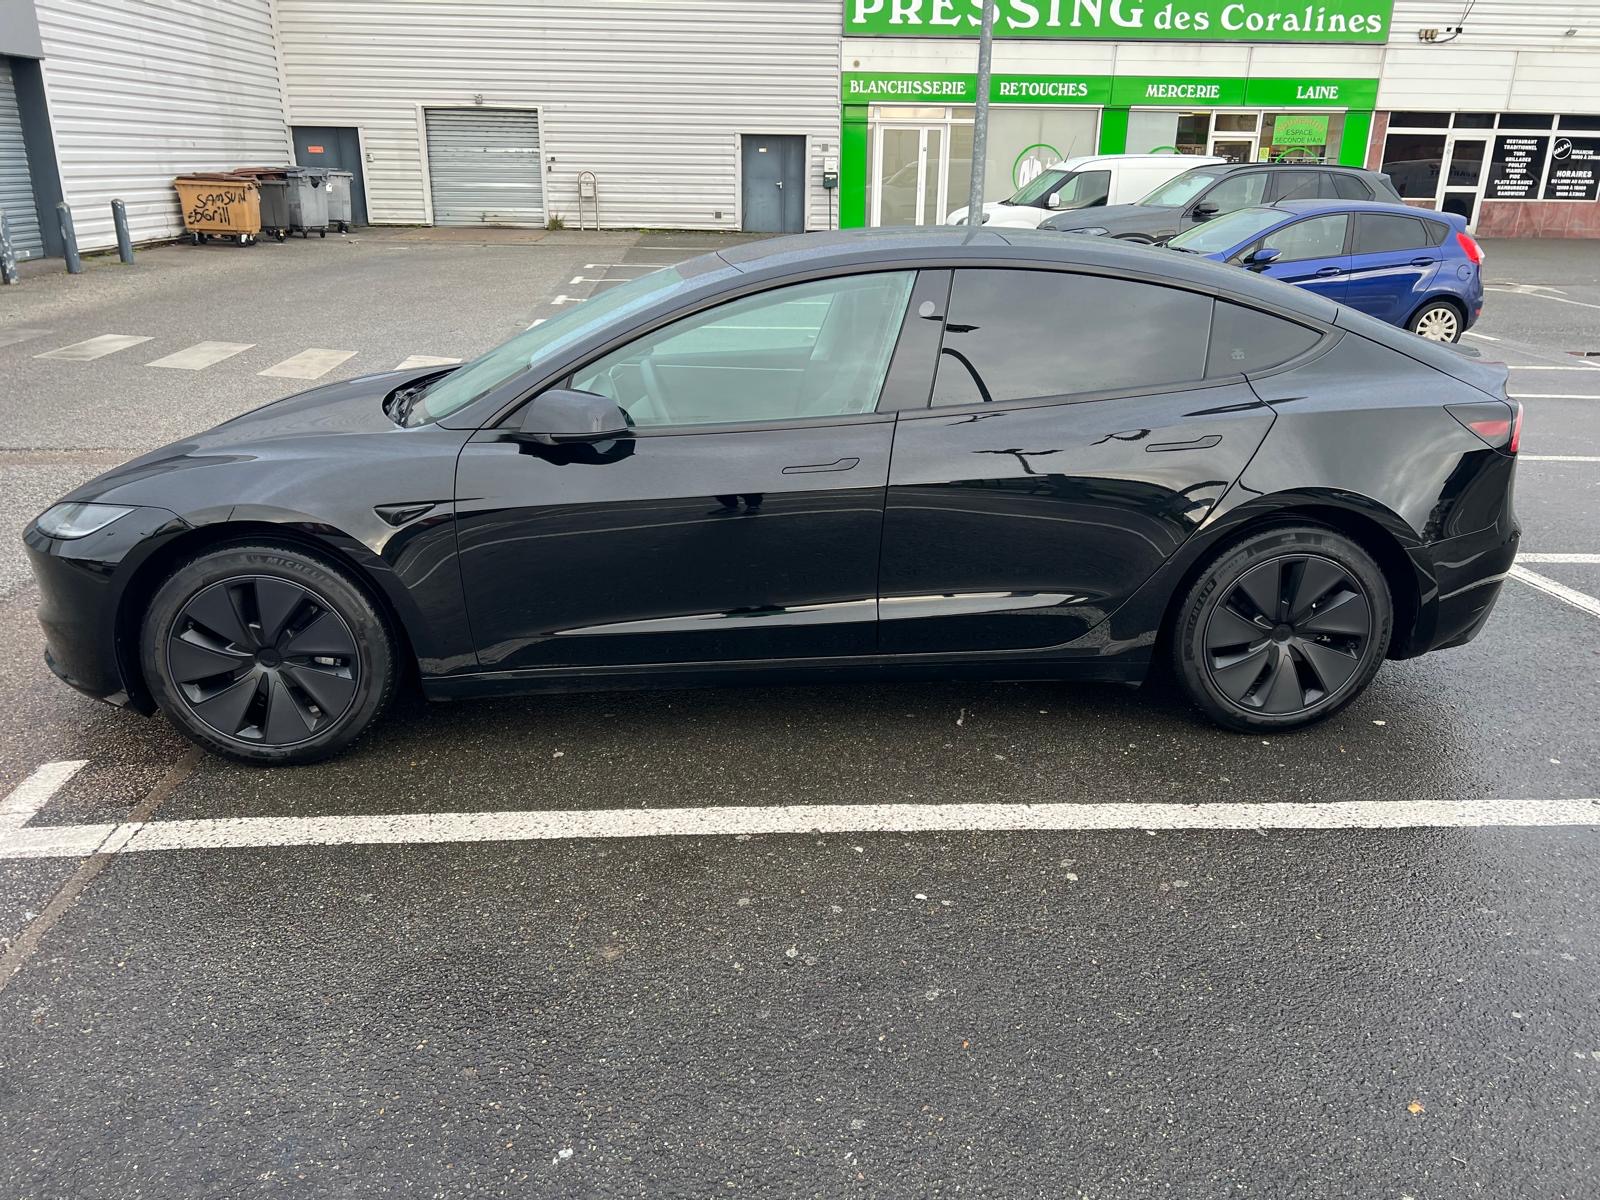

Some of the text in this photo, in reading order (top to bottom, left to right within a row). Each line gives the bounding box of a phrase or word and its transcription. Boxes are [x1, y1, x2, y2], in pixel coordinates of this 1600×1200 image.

[852, 0, 1382, 34] PRESSING des Coralines
[849, 79, 967, 96] BLANCHISSERIE
[999, 82, 1088, 97] RETOUCHES
[1145, 83, 1220, 99] MERCERIE
[1296, 85, 1339, 100] LAINE
[1286, 128, 1313, 136] ESPACE
[1554, 142, 1571, 155] HALAL
[1556, 170, 1593, 178] HORAIRES
[195, 187, 247, 209] SAMSUN
